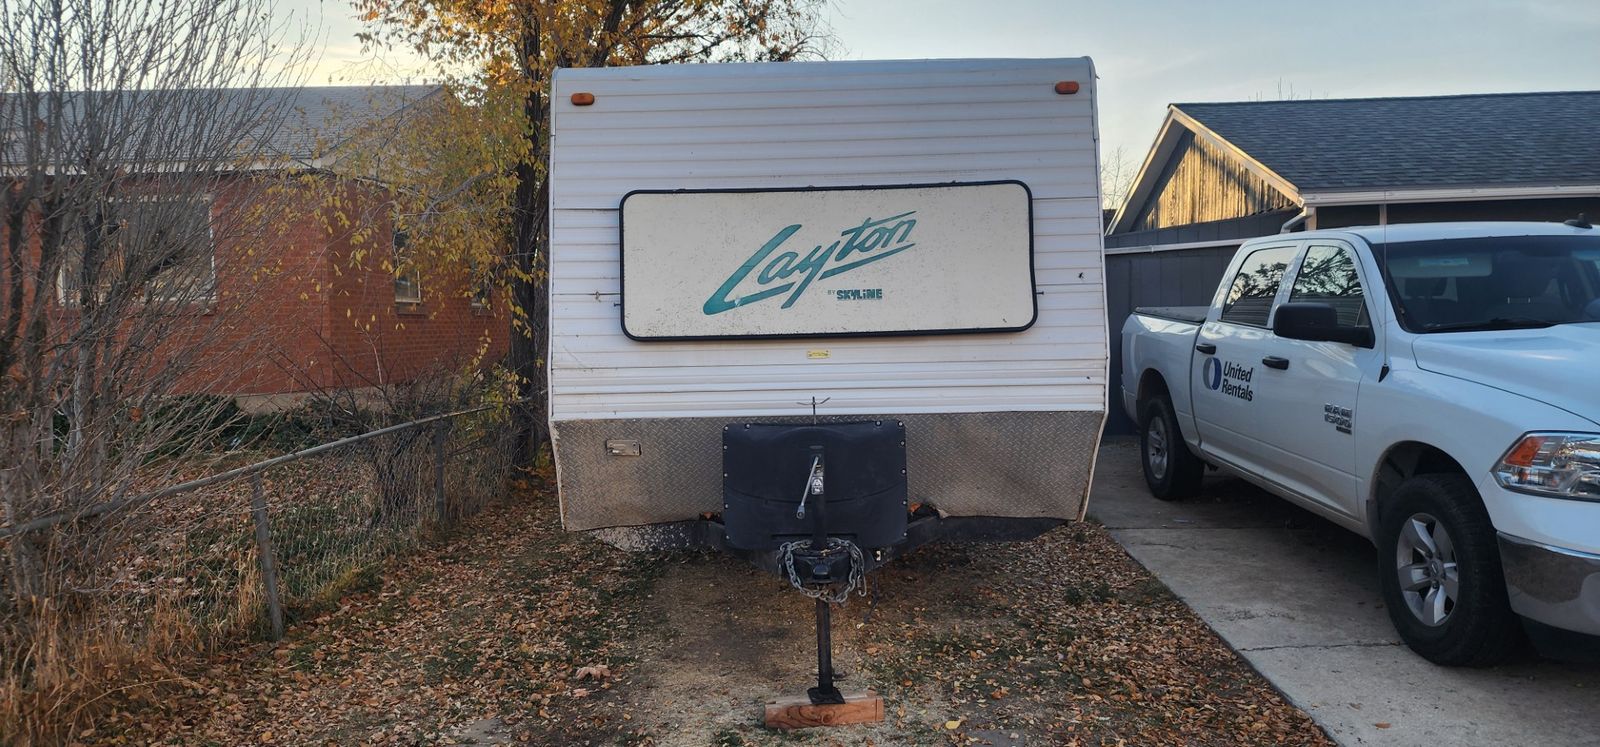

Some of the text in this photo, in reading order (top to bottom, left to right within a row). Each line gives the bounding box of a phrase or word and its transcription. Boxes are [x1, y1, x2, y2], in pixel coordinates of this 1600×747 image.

[703, 211, 917, 315] Layton
[1223, 361, 1254, 383] United
[1221, 378, 1254, 402] Rentals
